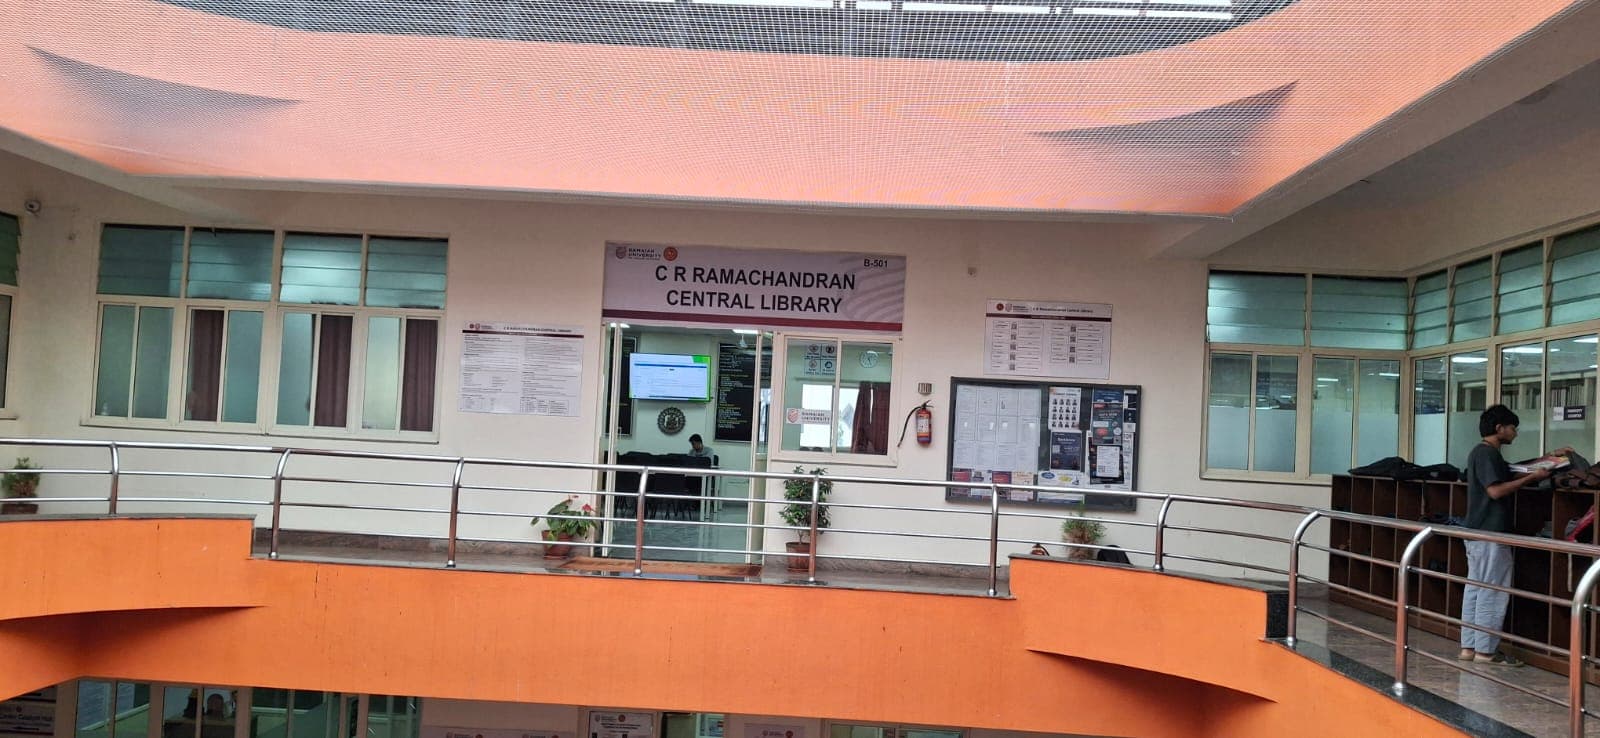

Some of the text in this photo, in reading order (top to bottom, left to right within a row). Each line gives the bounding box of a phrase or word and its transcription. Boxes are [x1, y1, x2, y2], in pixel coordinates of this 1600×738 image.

[864, 258, 888, 268] B-501
[655, 265, 856, 290] C R RAMACHANDRAN
[666, 290, 843, 314] CENTRAL LIBRARY
